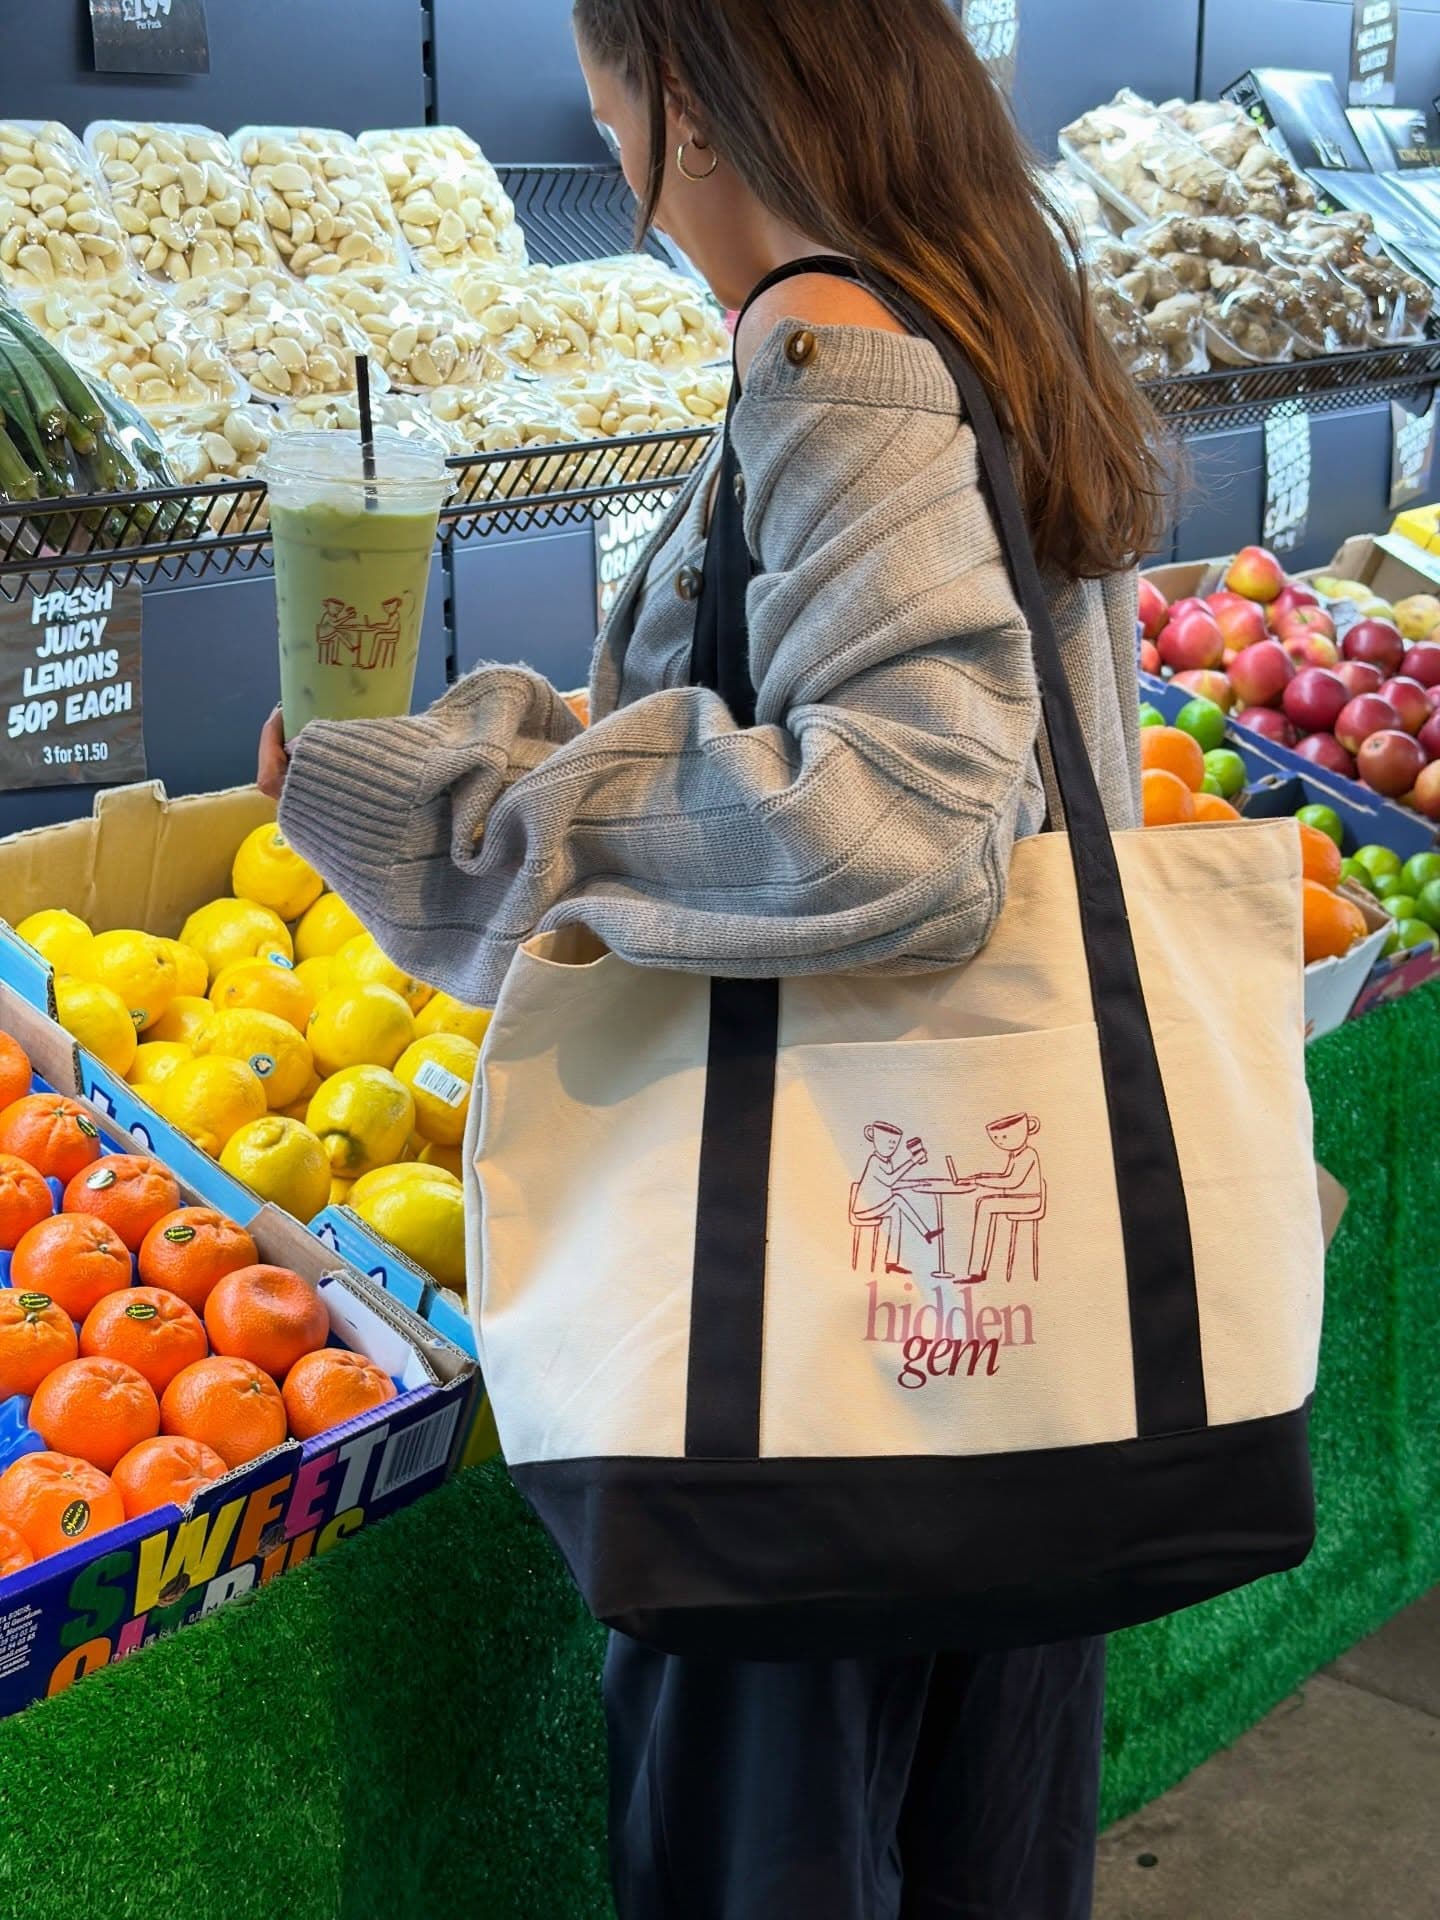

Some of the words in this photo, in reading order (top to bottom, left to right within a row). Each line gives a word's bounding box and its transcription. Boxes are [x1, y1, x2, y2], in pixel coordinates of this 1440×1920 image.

[31, 580, 113, 625] FRESH
[36, 616, 107, 658] JUICY
[23, 649, 119, 697] LEMONS
[7, 699, 58, 738] 50P
[65, 682, 132, 725] EACH
[43, 746, 53, 764] 3
[53, 744, 73, 764] for
[74, 742, 108, 762] £1.50
[863, 1279, 1036, 1347] hidden
[897, 1335, 1001, 1390] gem
[60, 1423, 390, 1647] SWEET
